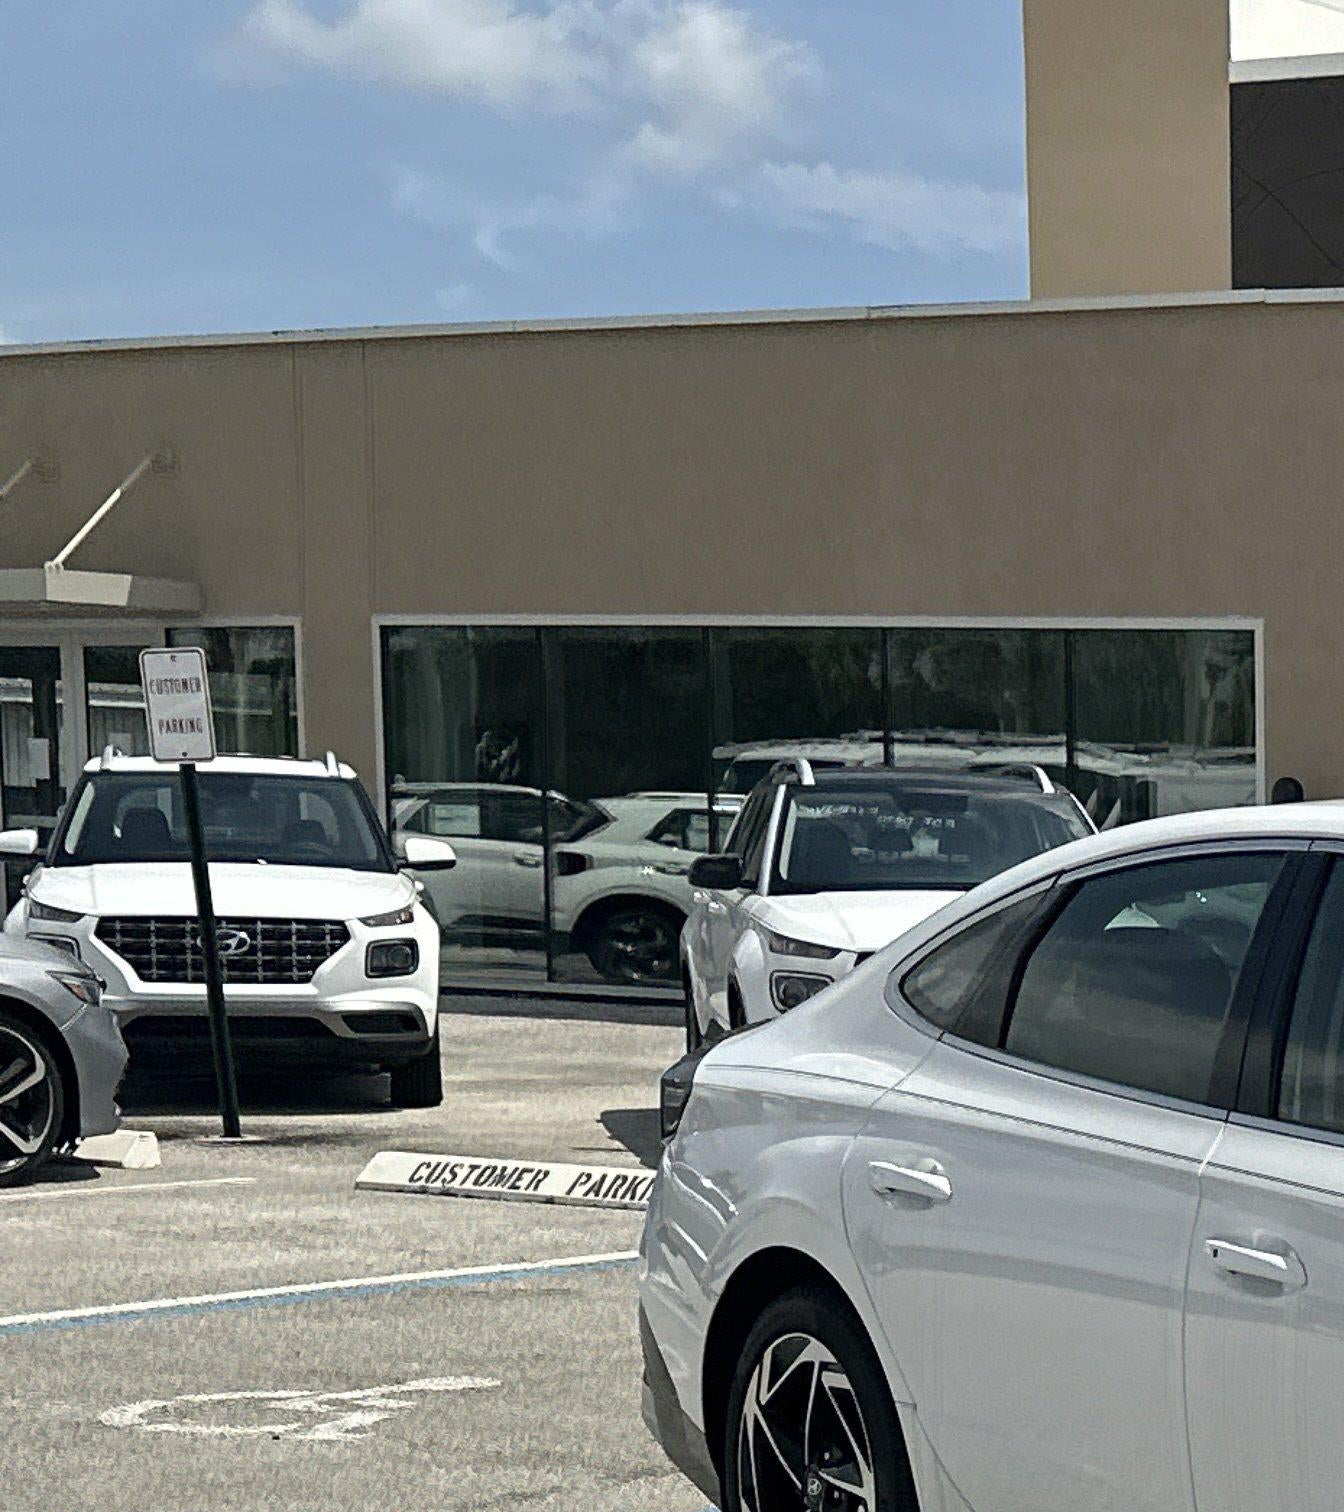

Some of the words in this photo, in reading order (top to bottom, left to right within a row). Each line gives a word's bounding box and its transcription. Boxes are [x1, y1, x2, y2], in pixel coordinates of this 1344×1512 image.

[149, 677, 202, 695] CUSTOMER
[158, 718, 203, 735] PARKING
[408, 1160, 550, 1192] CUSTOMER
[565, 1170, 656, 1202] PARKI
